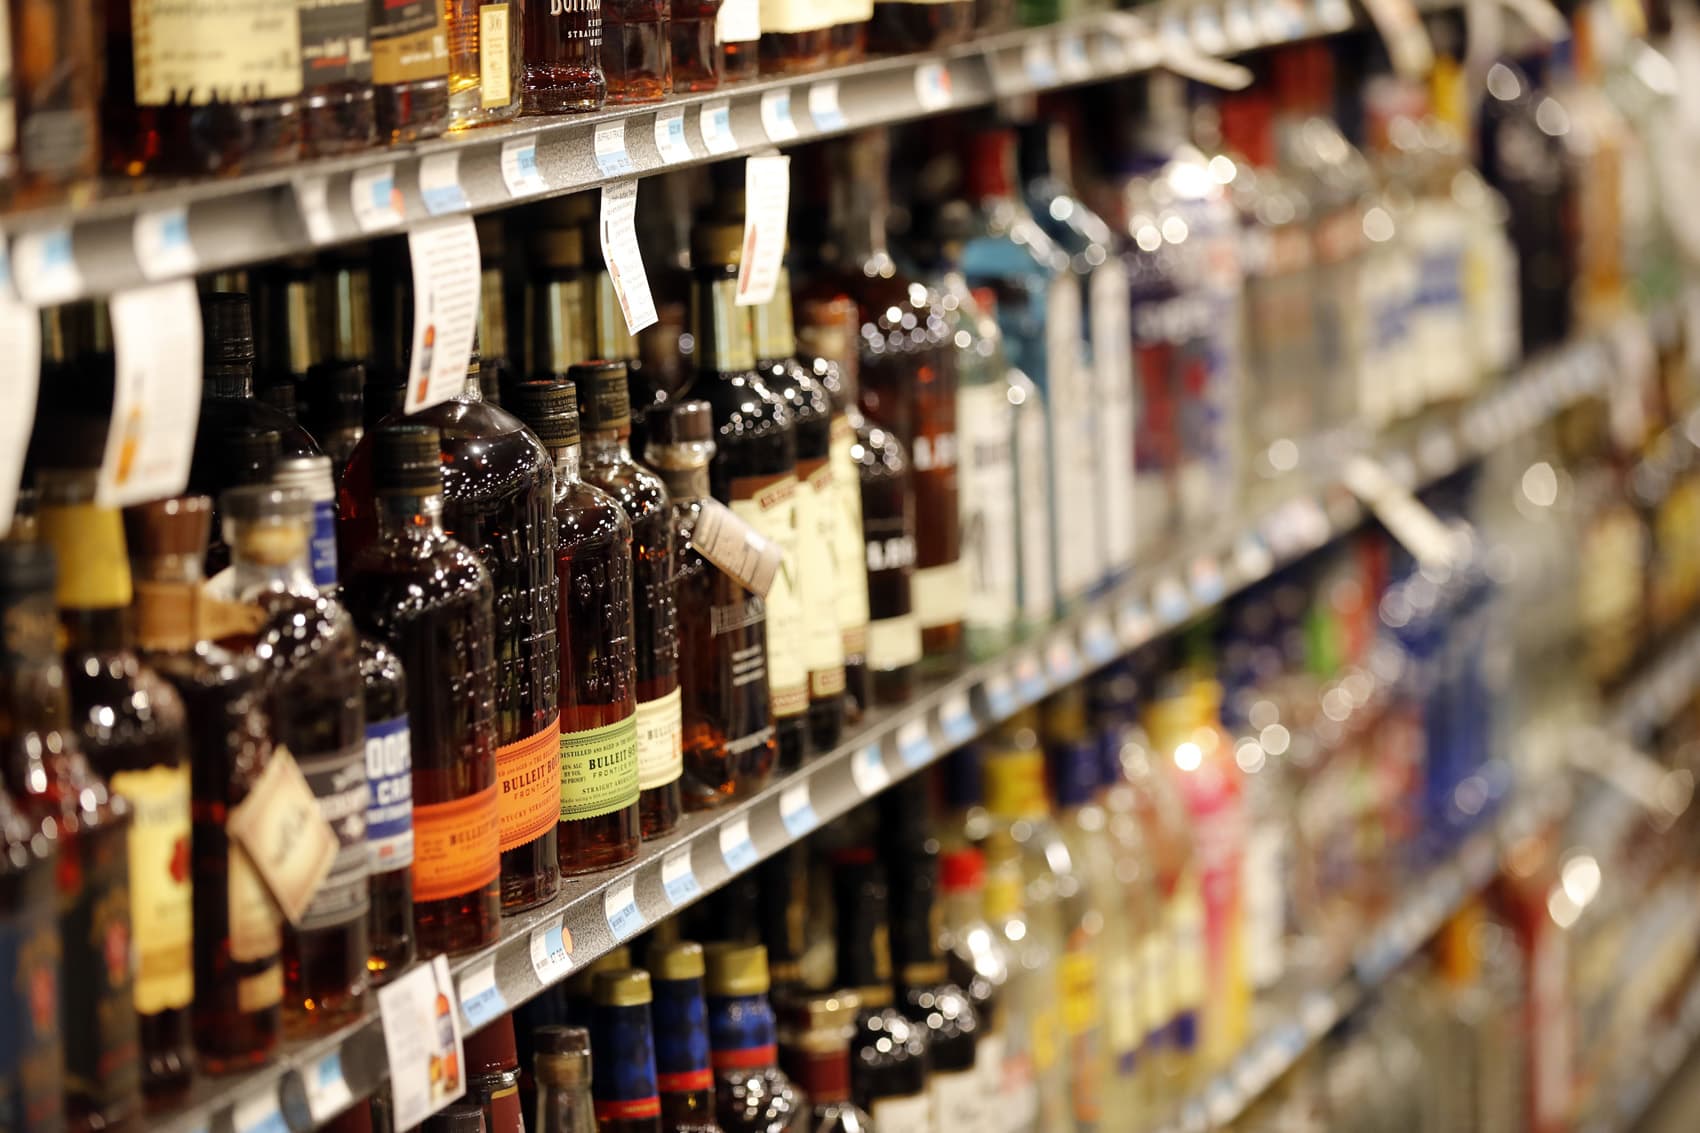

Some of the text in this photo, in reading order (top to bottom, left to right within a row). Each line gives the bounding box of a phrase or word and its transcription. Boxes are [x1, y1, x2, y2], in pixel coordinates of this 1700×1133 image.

[589, 750, 627, 770] BULLEIT
[503, 764, 546, 794] BULLEIT
[582, 783, 614, 794] STRAIGHT
